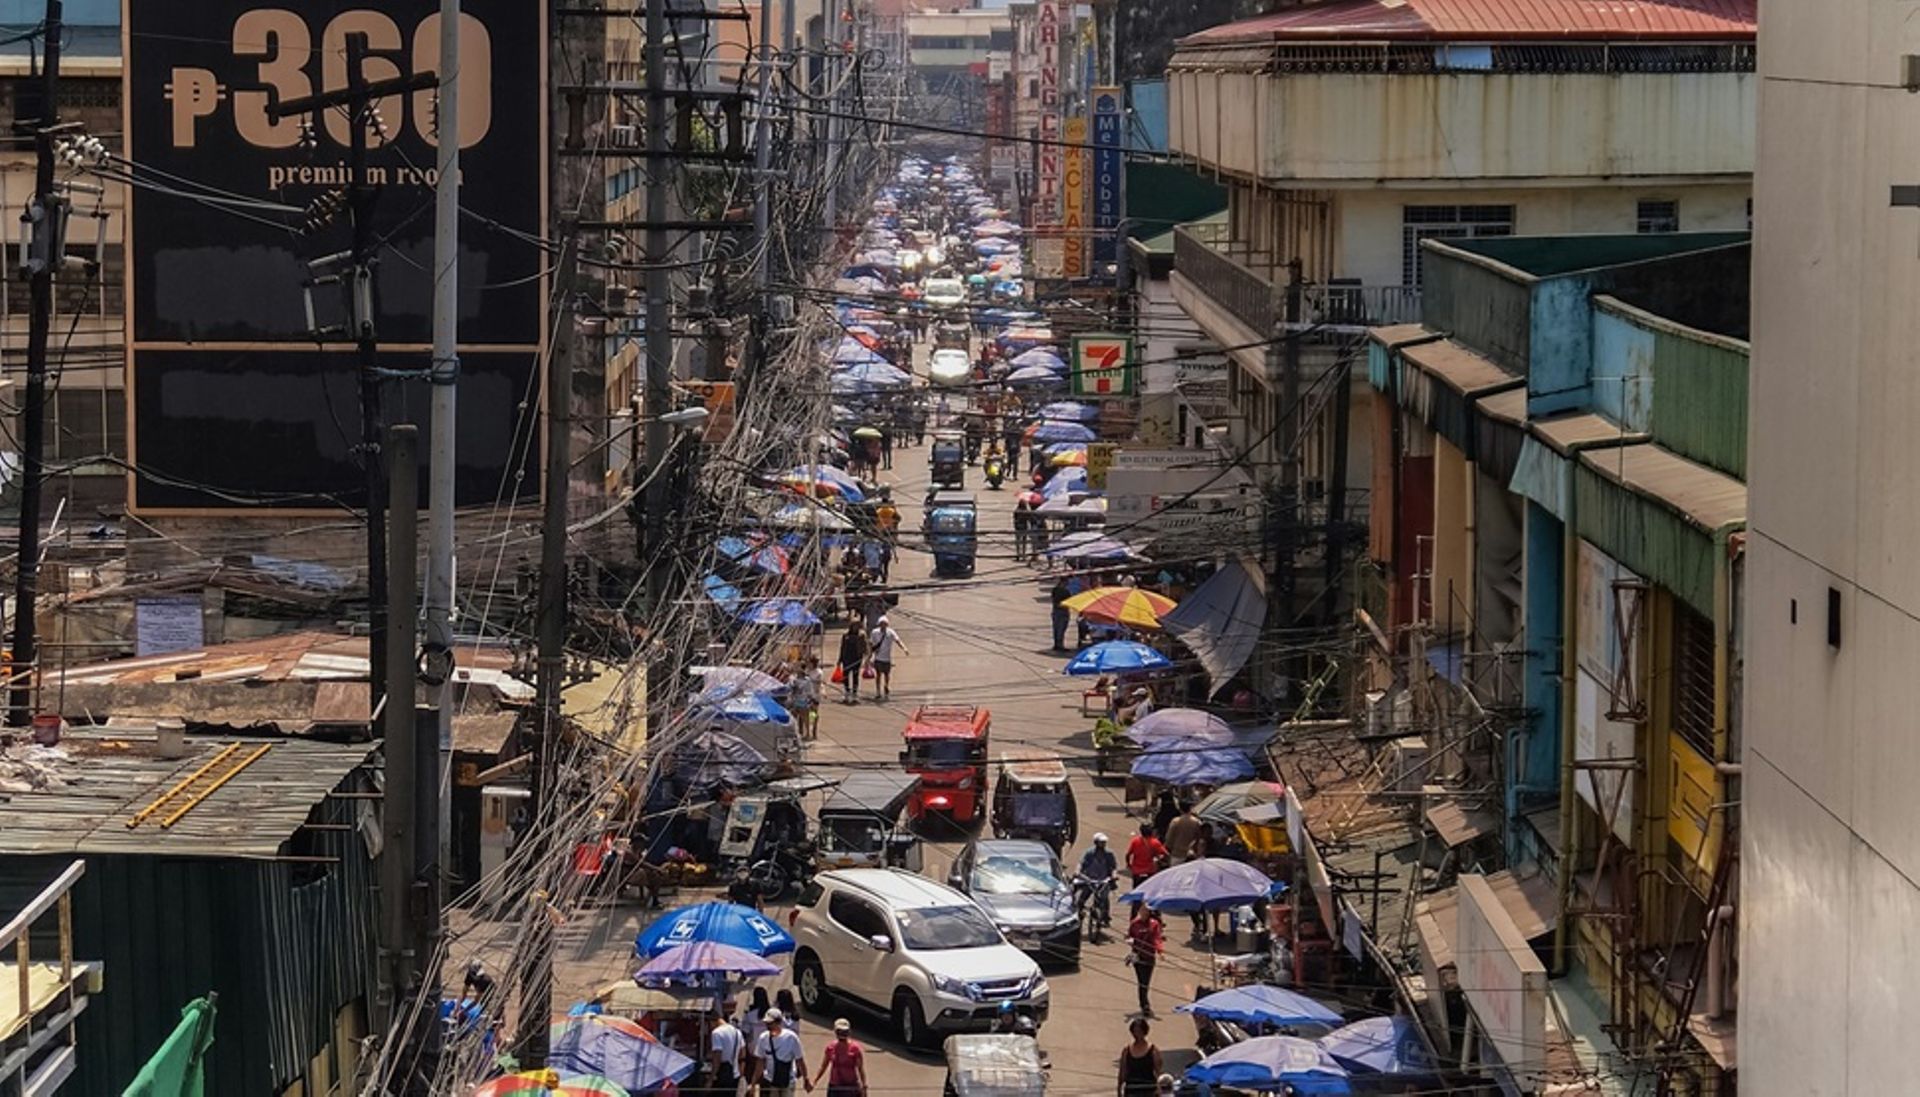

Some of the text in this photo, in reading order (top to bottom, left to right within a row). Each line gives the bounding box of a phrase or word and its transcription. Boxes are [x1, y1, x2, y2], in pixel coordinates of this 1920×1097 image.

[398, 169, 463, 186] roo
[1042, 114, 1057, 225] CENTE
[1100, 117, 1114, 241] Metrobank
